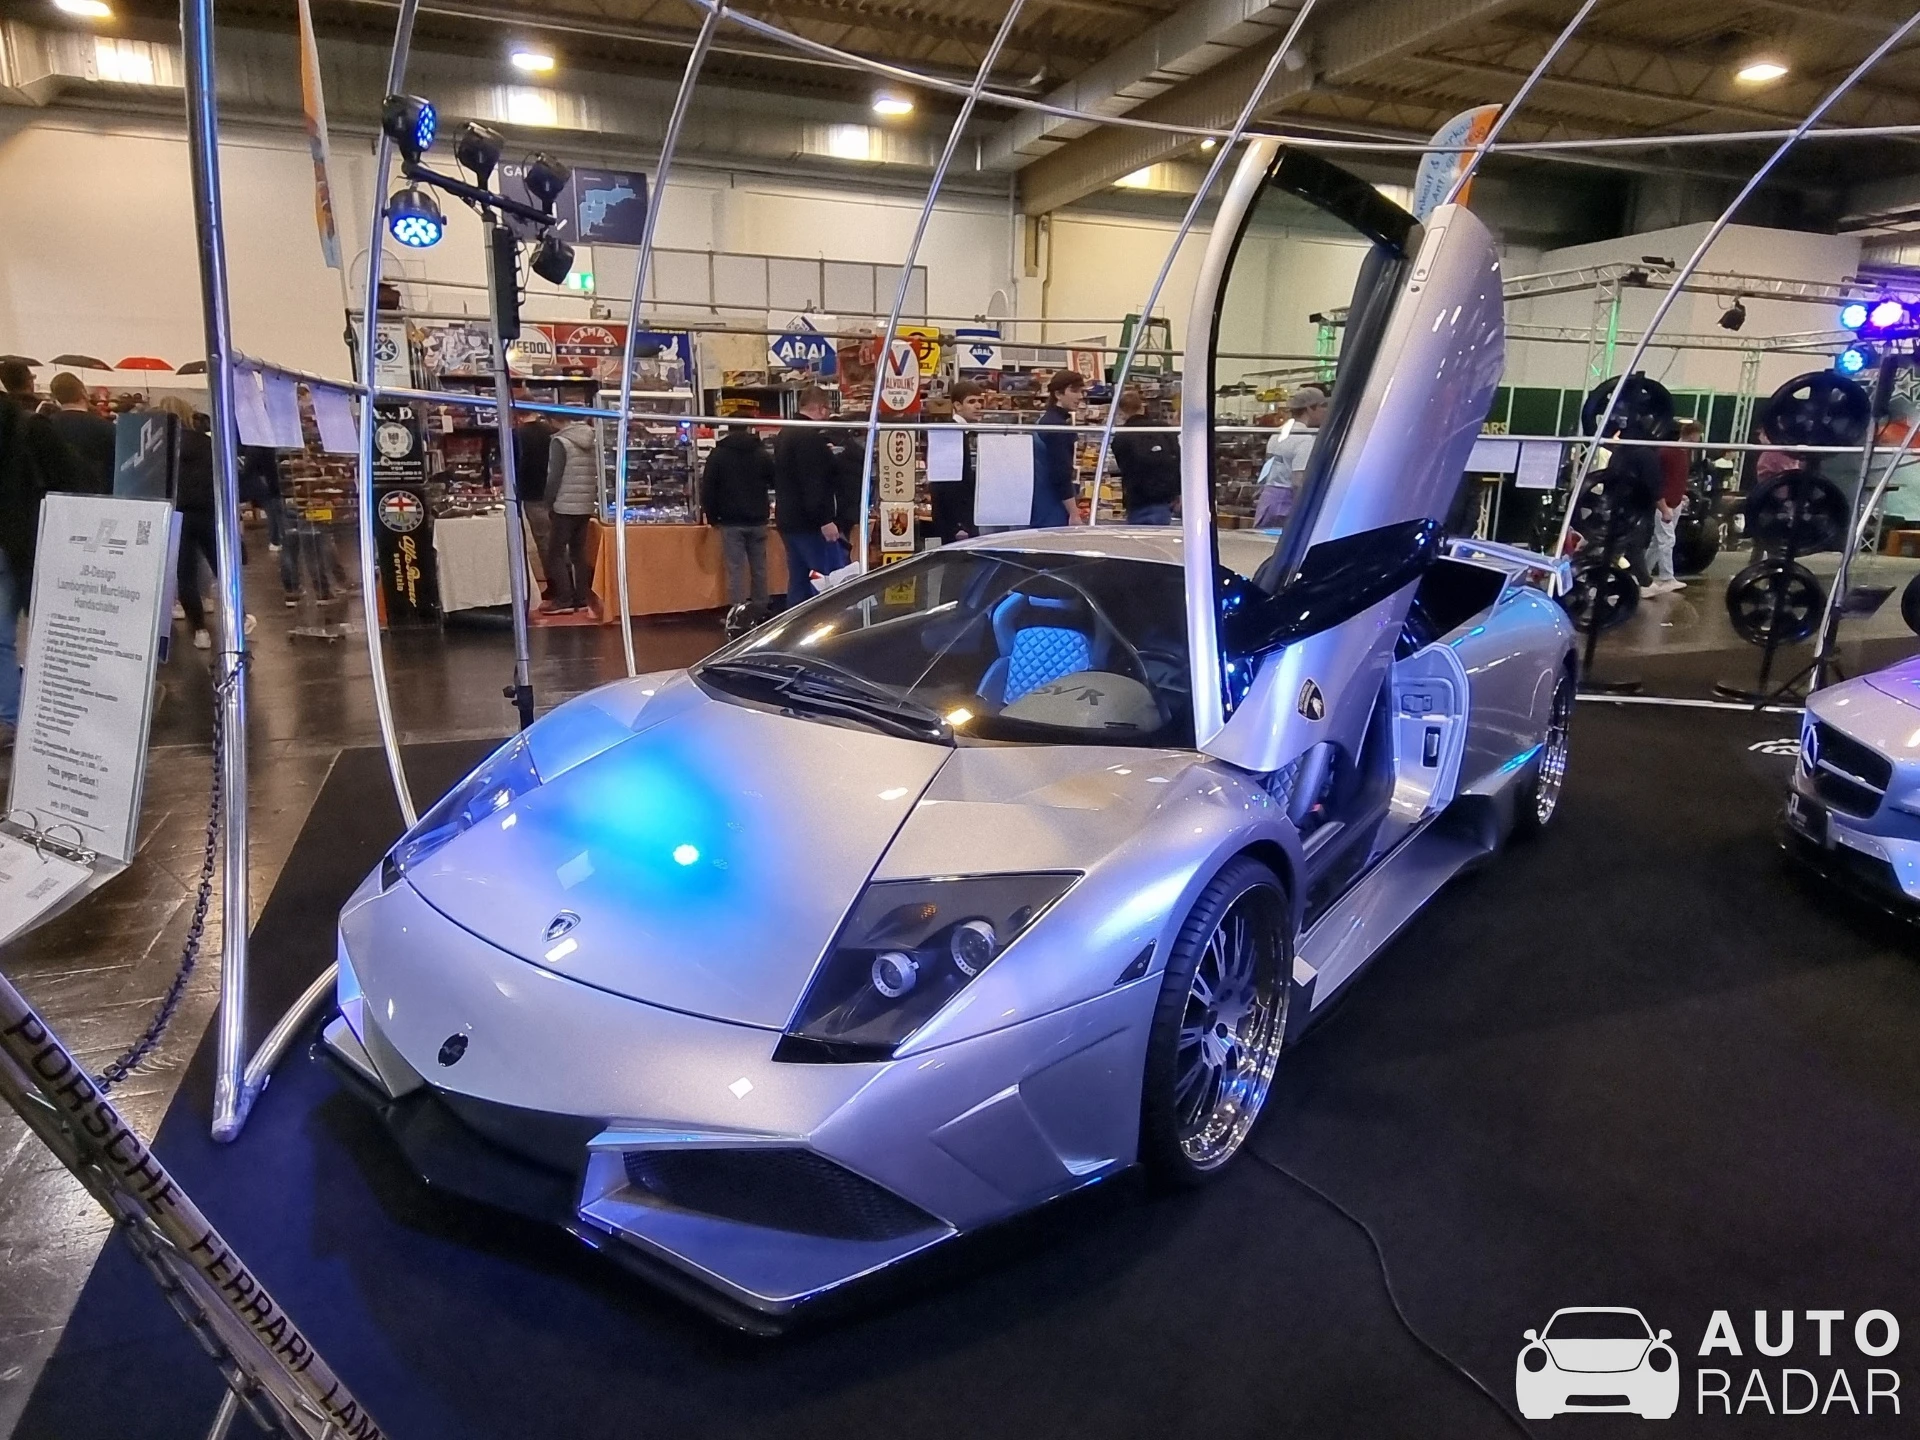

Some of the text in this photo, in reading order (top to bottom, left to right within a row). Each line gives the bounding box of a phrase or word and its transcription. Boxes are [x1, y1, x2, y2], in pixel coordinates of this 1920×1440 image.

[895, 471, 904, 495] GAS
[4, 1011, 384, 1440] PORSCHE FERRARI LAM
